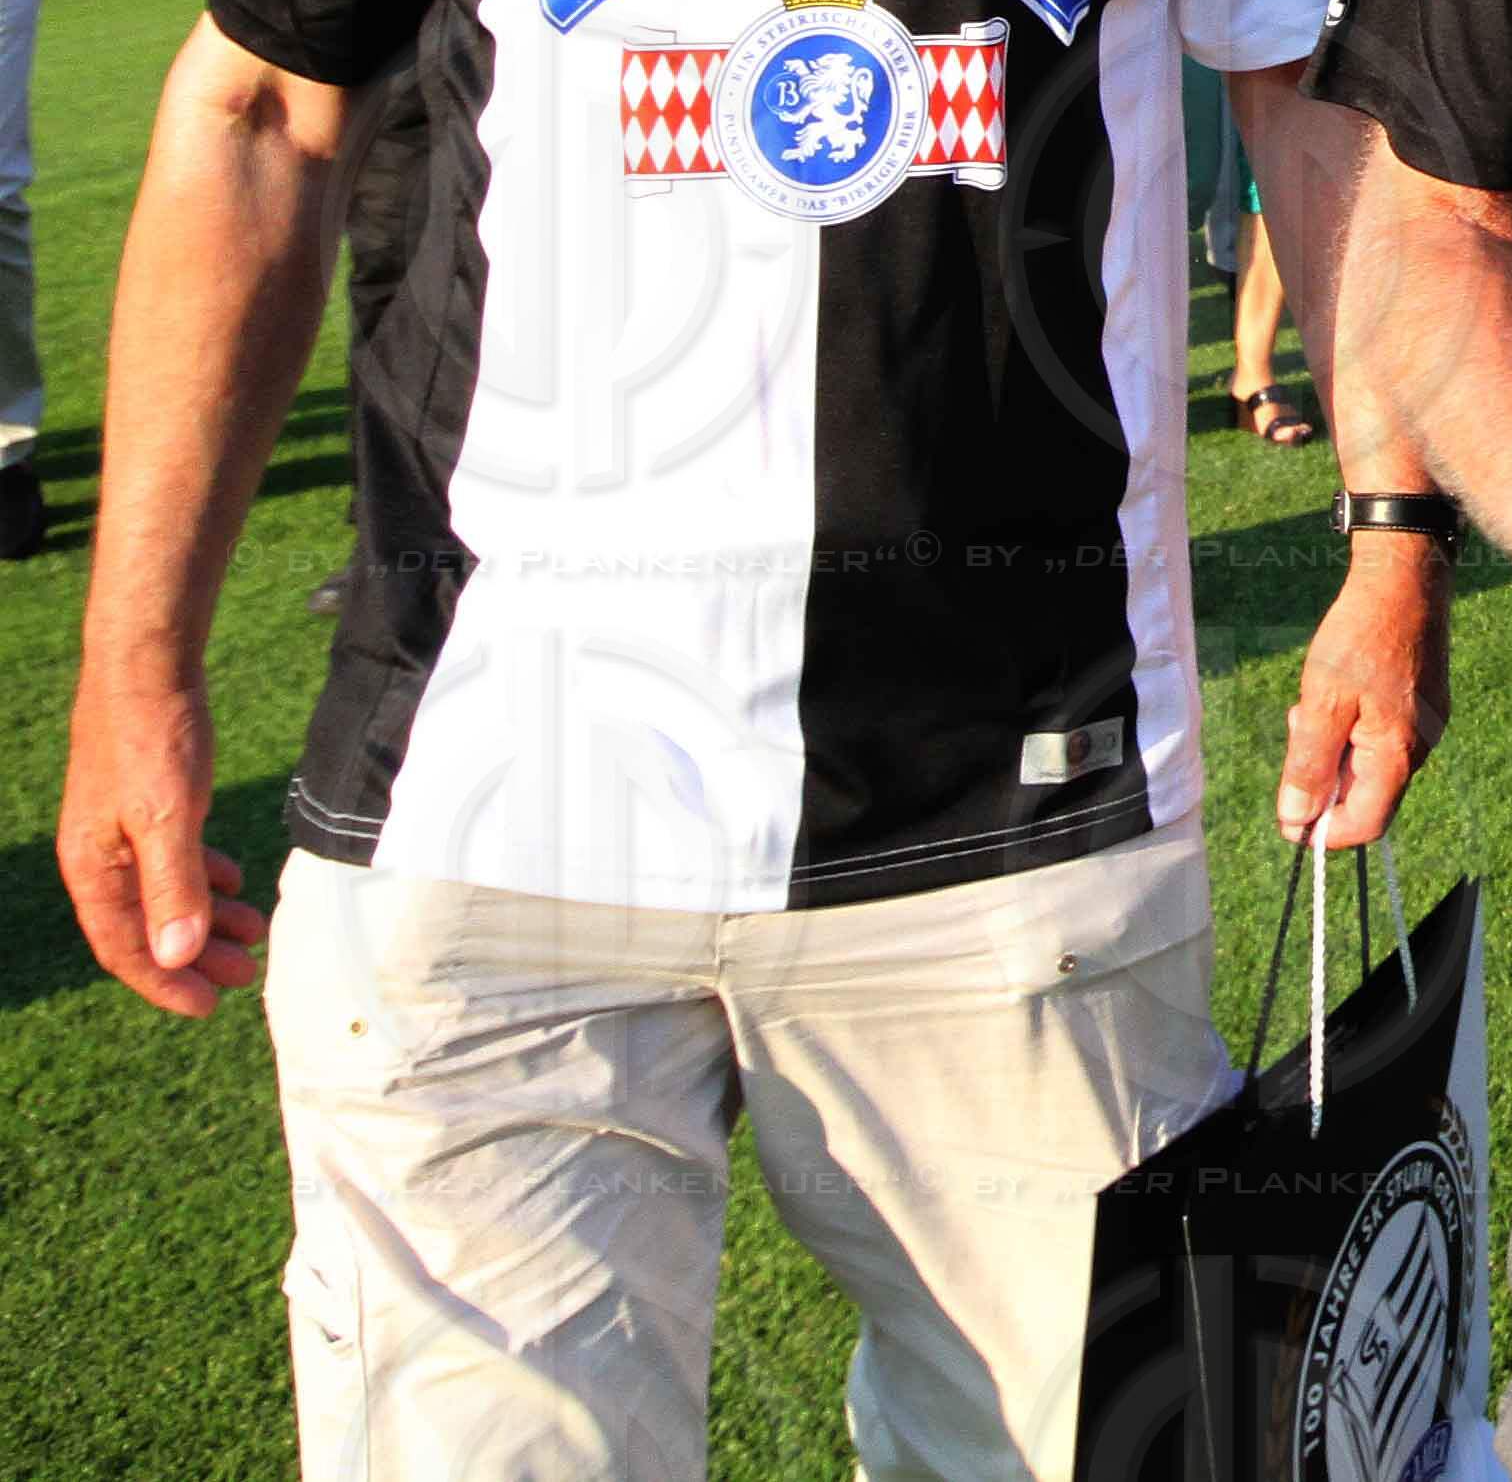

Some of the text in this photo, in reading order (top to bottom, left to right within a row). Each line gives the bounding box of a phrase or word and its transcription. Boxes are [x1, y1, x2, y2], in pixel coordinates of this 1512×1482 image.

[1303, 1382, 1324, 1457] 100
[1314, 1244, 1362, 1367] JAHRE
[1361, 1197, 1385, 1242] SK
